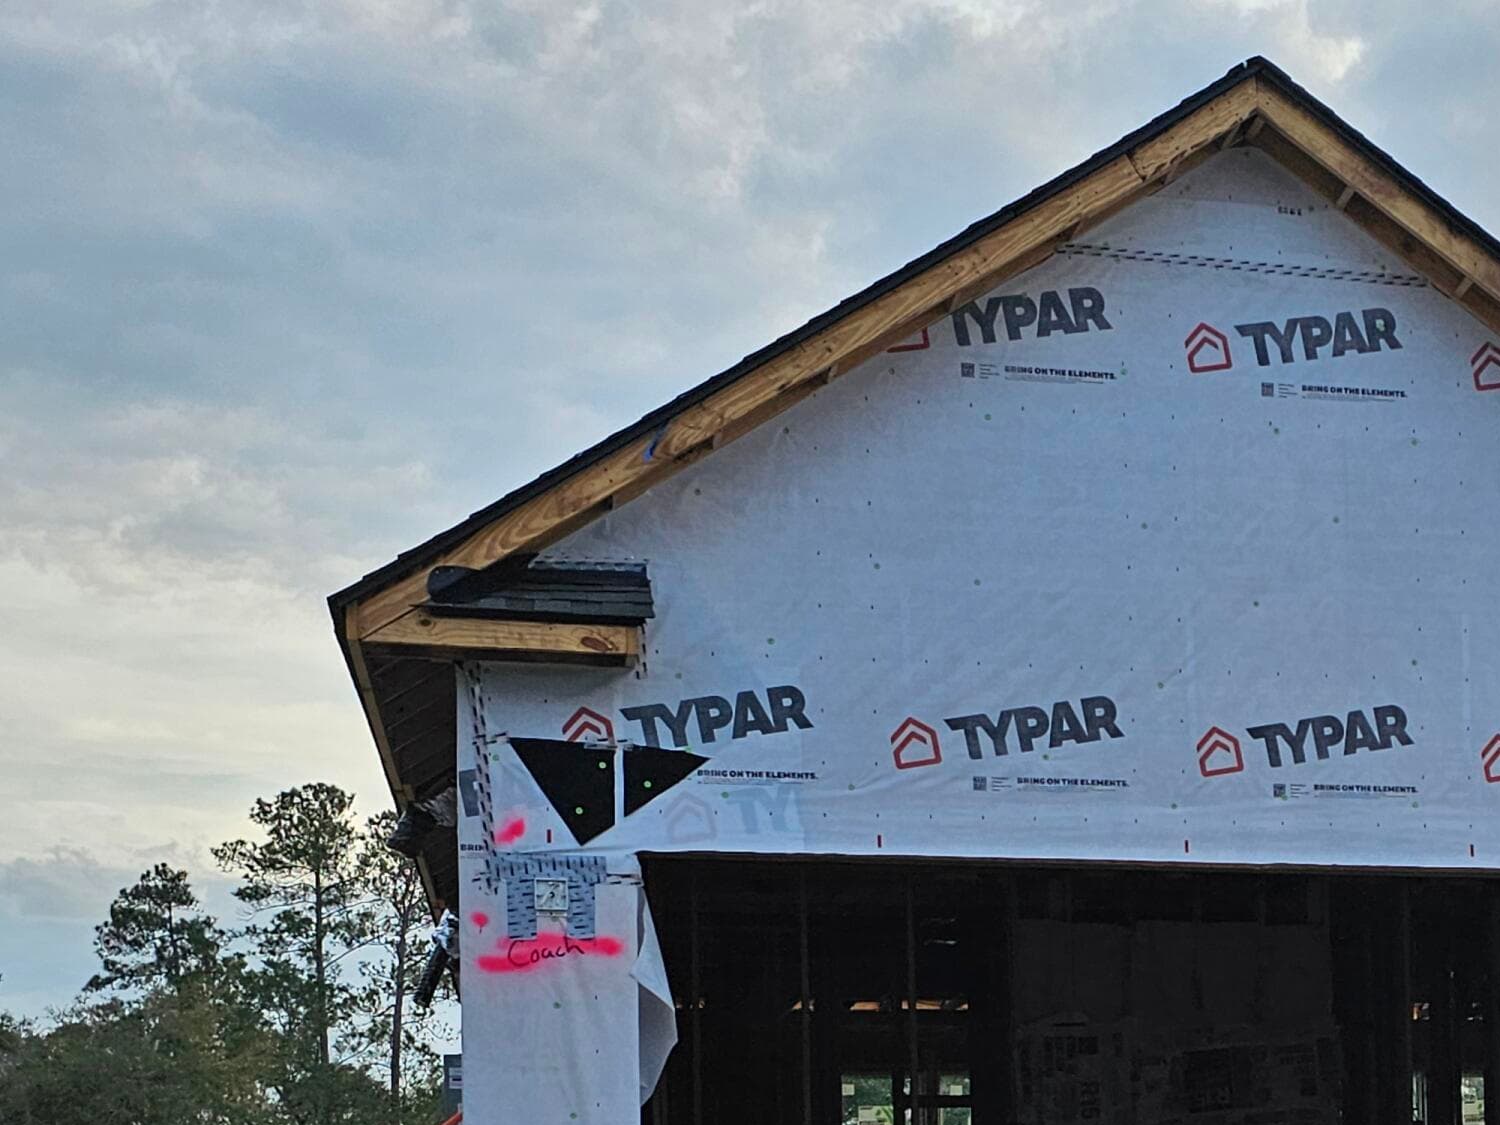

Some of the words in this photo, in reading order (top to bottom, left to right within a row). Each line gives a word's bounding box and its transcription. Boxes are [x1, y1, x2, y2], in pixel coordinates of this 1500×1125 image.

[1234, 307, 1403, 366] TYPAR
[620, 685, 814, 749] TYPAR
[943, 695, 1125, 760] TYPAR
[1246, 704, 1415, 768] TYPAR
[697, 769, 728, 778] BRING
[729, 770, 744, 778] ON
[1017, 776, 1045, 785] BRING
[1046, 777, 1060, 785] ON
[1061, 777, 1079, 786] THE
[1355, 784, 1372, 792] THE
[507, 938, 587, 968] Coach
